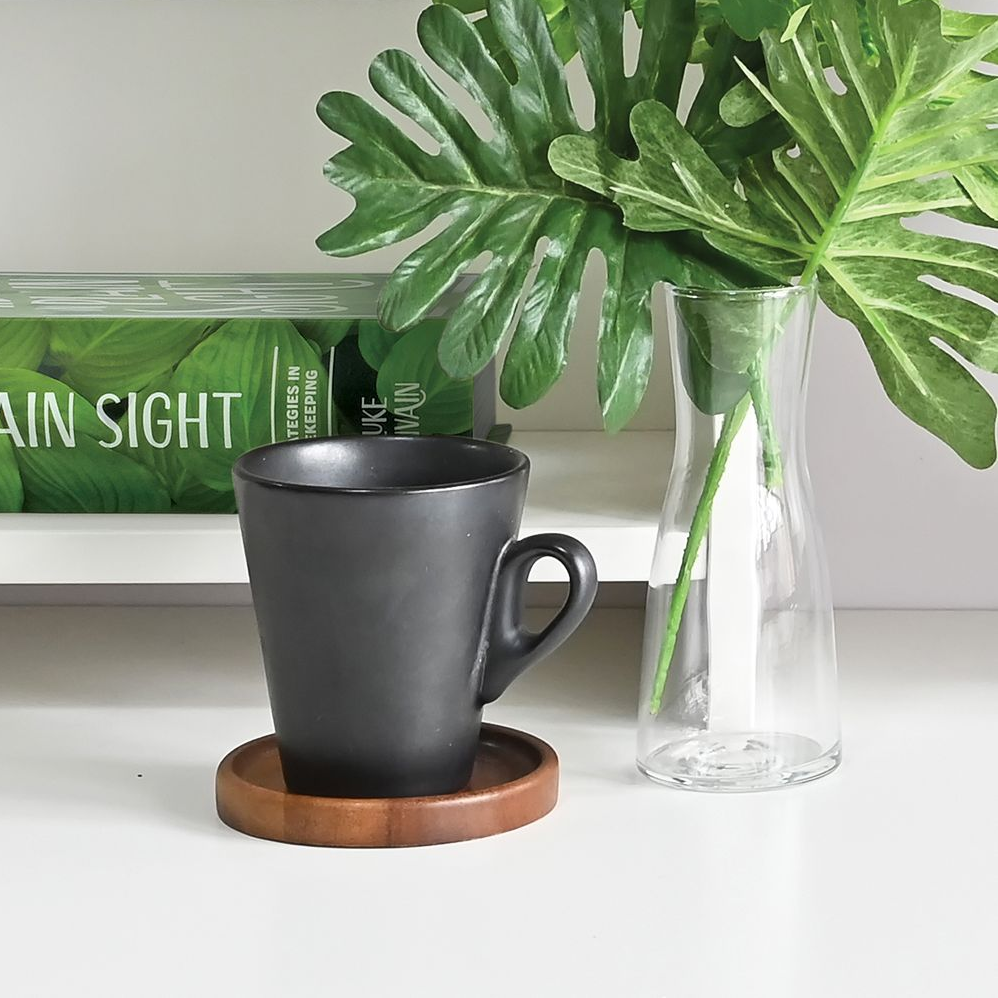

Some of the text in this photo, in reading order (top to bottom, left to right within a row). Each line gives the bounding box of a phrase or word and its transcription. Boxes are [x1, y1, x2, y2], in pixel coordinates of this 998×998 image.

[287, 366, 301, 381] IN
[96, 392, 243, 449] SIGHT
[304, 369, 318, 439] KEEPING
[361, 396, 387, 435] UKE
